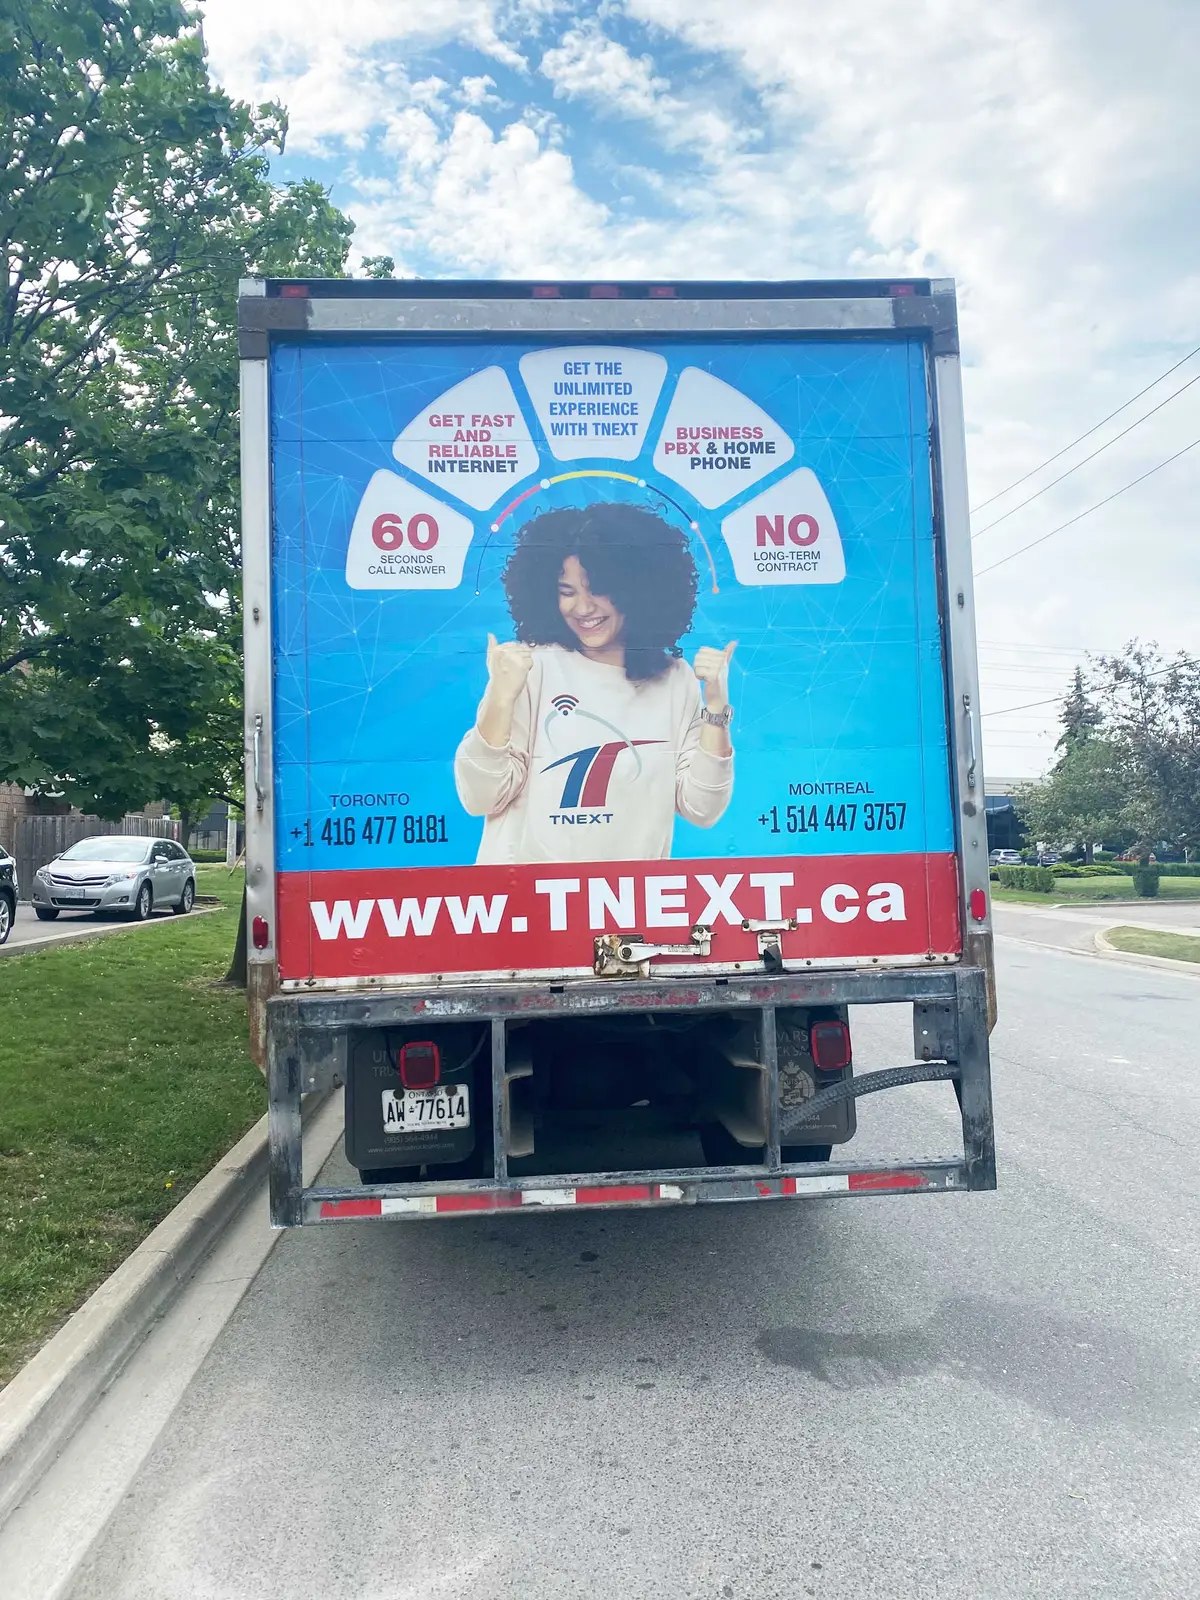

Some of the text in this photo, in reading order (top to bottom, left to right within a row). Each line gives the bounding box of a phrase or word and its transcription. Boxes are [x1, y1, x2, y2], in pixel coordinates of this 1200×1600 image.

[563, 361, 622, 376] GET THE
[553, 382, 633, 396] UNLIMITED
[550, 402, 639, 417] EXPERIENCE
[429, 414, 516, 428] GET FAST
[453, 429, 492, 443] AND
[551, 422, 639, 437] WITH TNEXT
[676, 426, 764, 440] BUSINESS
[428, 444, 518, 458] RELIABLE
[664, 441, 776, 455] PBX & HOME
[427, 459, 518, 473] INTERNET
[690, 457, 751, 470] PHONE
[371, 512, 440, 551] 60
[755, 513, 820, 547] NO
[380, 555, 433, 564] SECONDS
[753, 551, 821, 561] LONG-TERM
[368, 565, 446, 575] CALL ANSWER
[757, 562, 818, 572] CONTRACT
[789, 781, 875, 796] MONTREAL
[329, 793, 410, 807] TORONTO
[549, 813, 614, 825] TNEXT
[758, 802, 907, 833] +1 514 447 3757
[290, 814, 448, 847] +1 416 477 8181
[309, 871, 908, 940] www.TNEXT.ca
[387, 1096, 465, 1123] AW 77614
